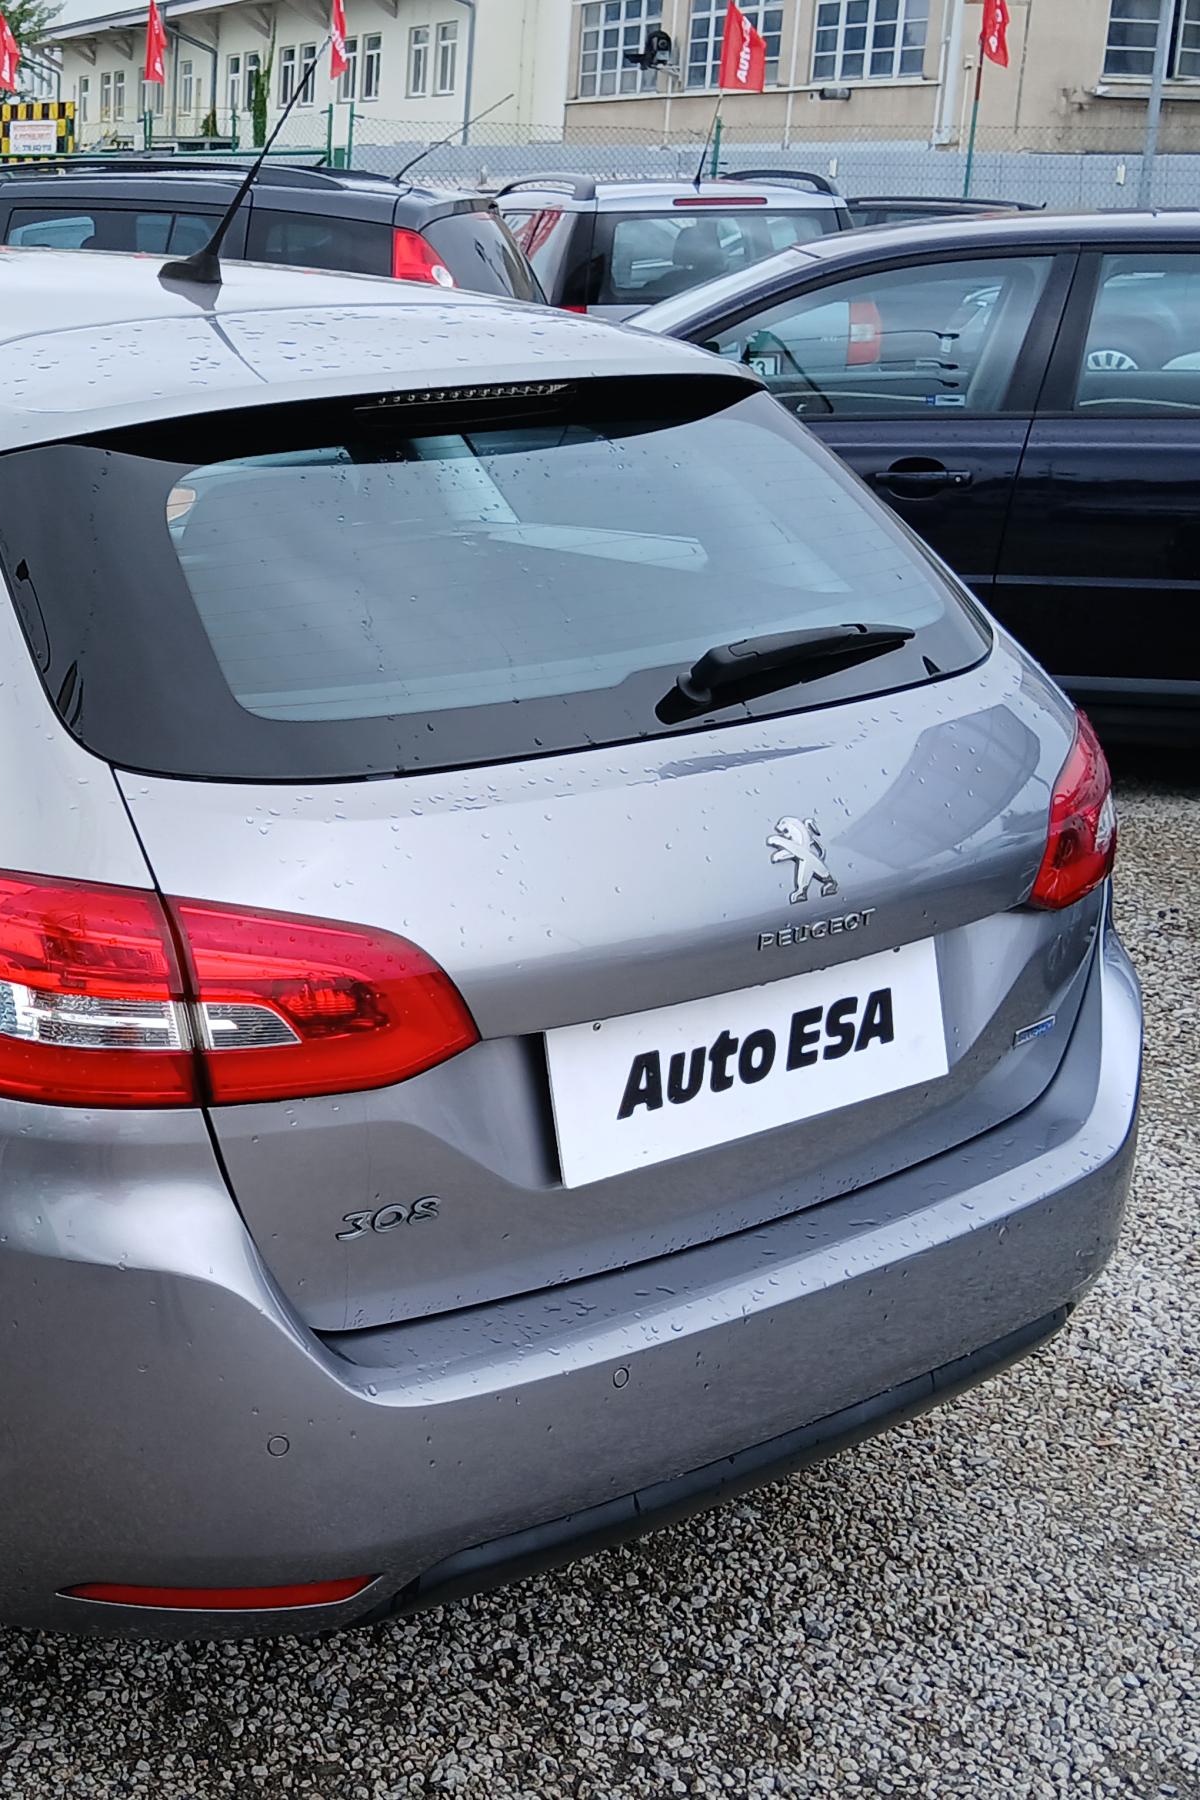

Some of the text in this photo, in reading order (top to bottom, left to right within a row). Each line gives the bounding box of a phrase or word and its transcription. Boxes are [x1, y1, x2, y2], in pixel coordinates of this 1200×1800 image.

[757, 908, 877, 951] PEUGEOT
[616, 987, 895, 1120] Auto ESA
[335, 1195, 442, 1241] 308
